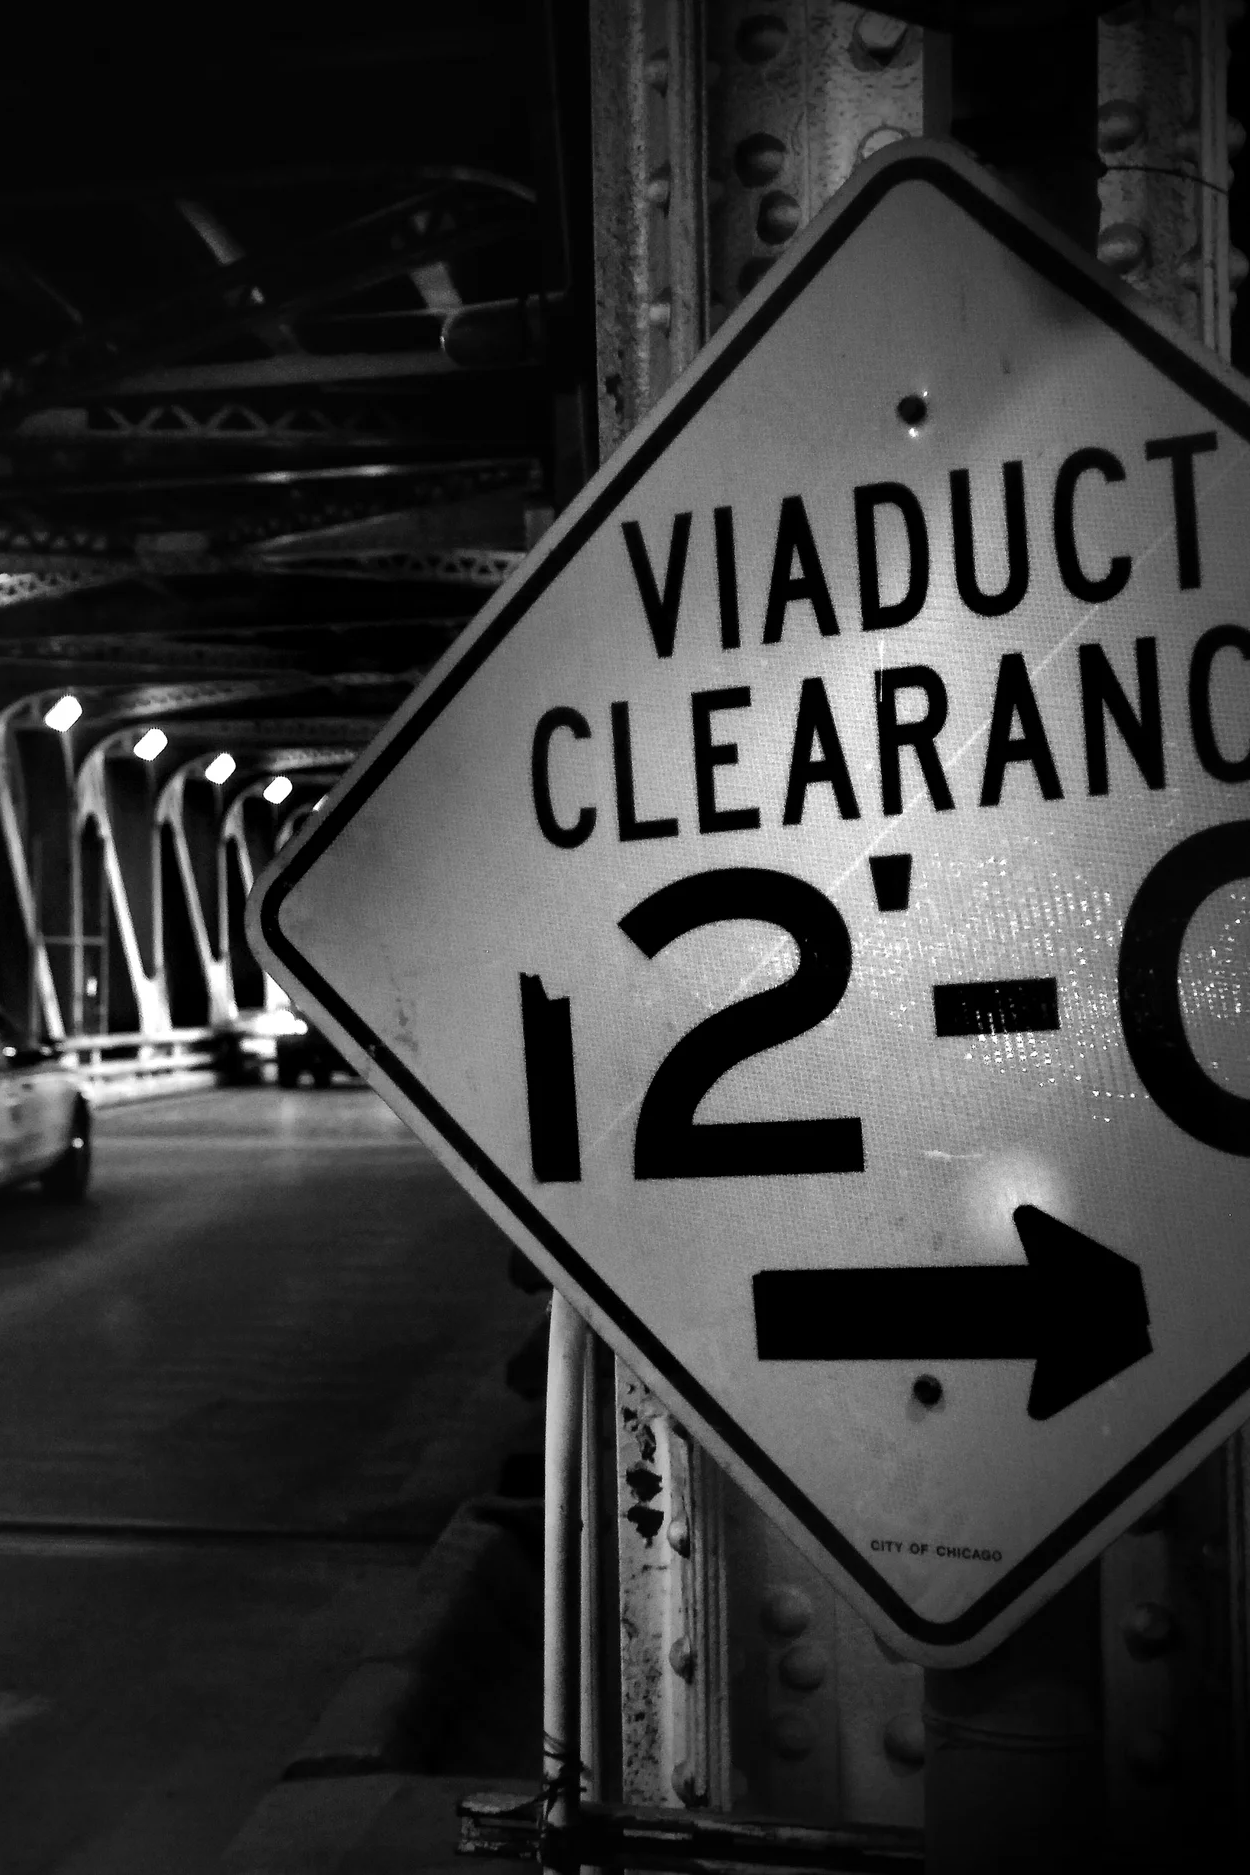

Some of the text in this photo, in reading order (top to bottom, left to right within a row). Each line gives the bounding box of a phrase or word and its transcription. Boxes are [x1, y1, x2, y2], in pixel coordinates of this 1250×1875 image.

[621, 430, 1219, 659] VIADUCT
[870, 1539, 1003, 1563] CITY OF CHICAGO
